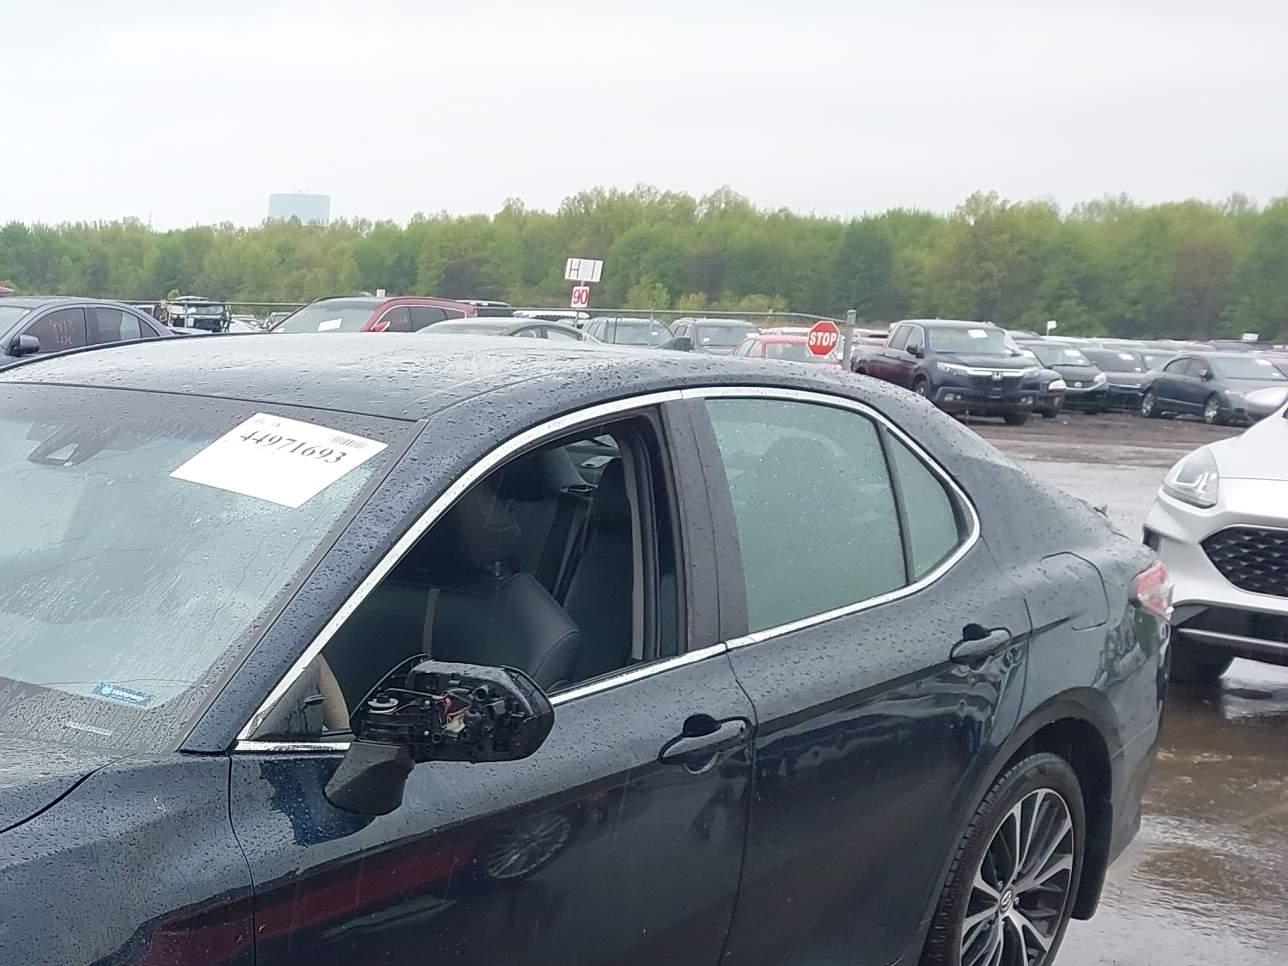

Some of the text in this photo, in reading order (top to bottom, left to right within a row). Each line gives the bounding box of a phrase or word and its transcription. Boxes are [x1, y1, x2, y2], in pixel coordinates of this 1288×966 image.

[568, 260, 581, 278] H
[809, 331, 837, 346] STOP
[239, 430, 347, 463] 44971693
